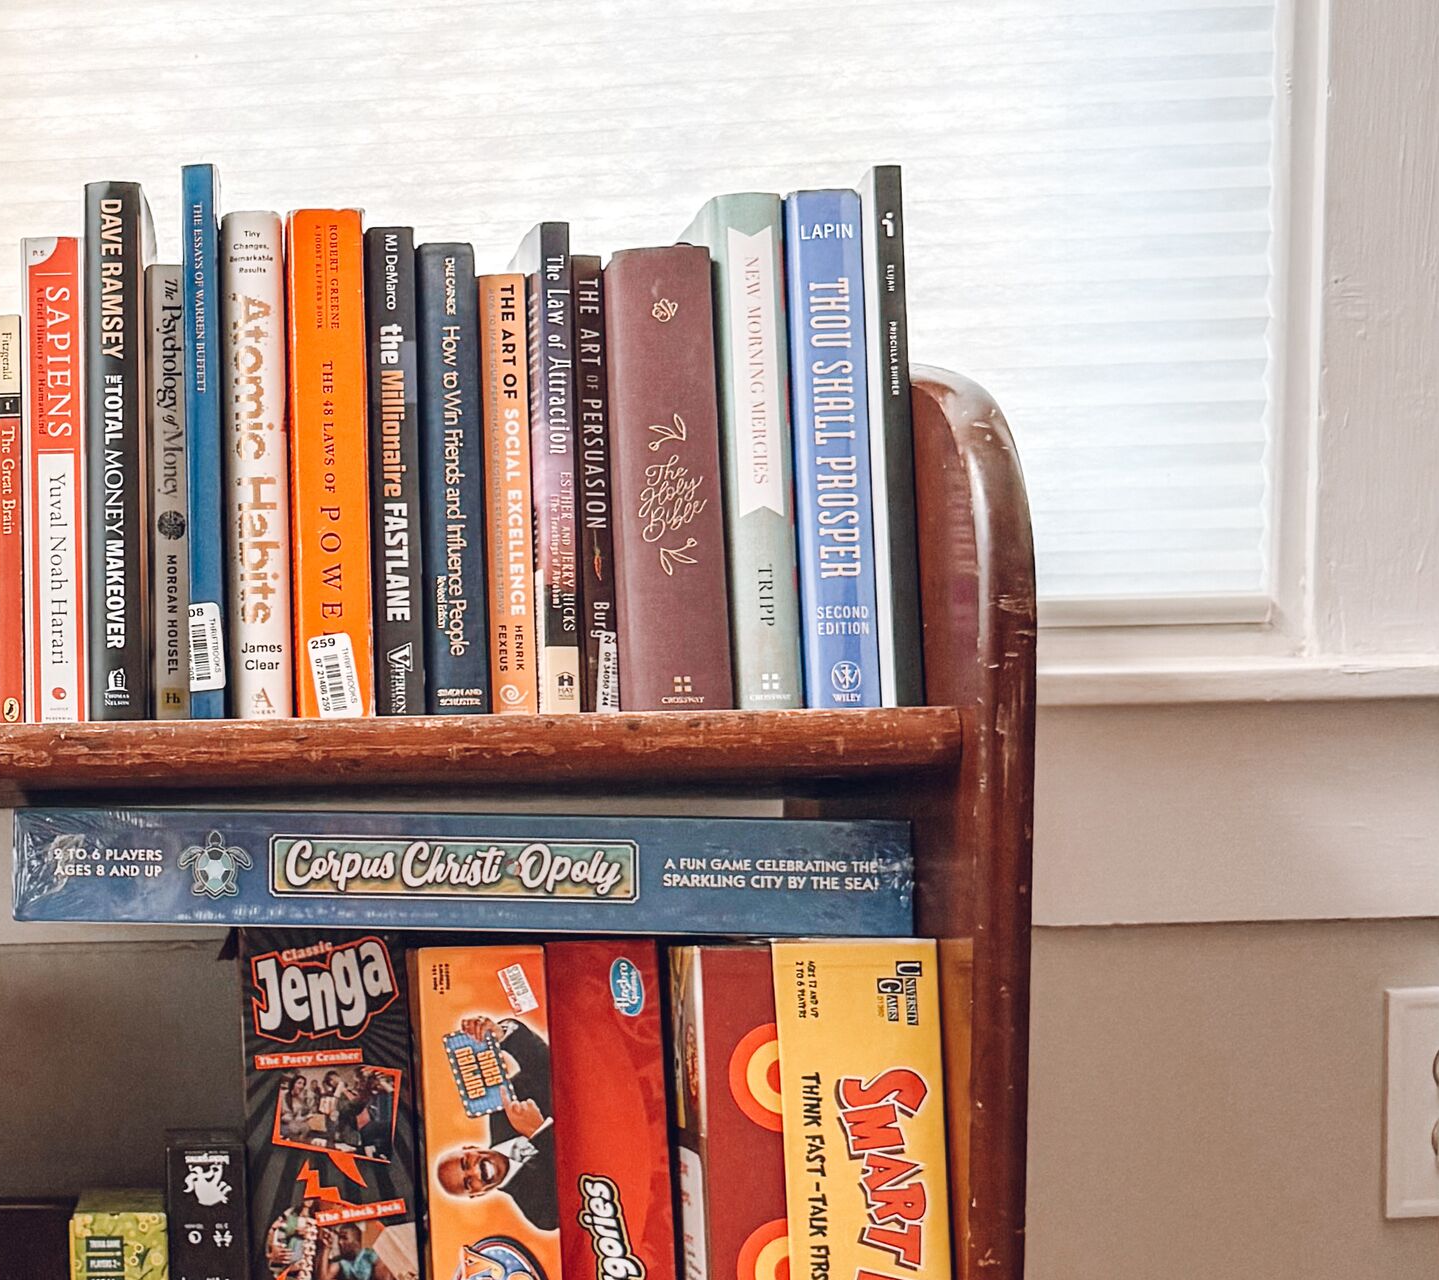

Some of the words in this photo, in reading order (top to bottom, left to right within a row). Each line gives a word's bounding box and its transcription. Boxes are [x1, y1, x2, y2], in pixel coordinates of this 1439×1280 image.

[100, 199, 122, 255] DAVE
[329, 225, 338, 273] ROBERT
[801, 224, 852, 240] LAPIN
[101, 263, 124, 359] RAMSEY
[330, 278, 340, 329] GREENE
[501, 285, 514, 321] THE
[809, 278, 851, 348] THOU
[46, 287, 72, 437] SAPIENS
[380, 323, 403, 364] the
[502, 330, 516, 366] ART
[323, 361, 333, 393] THE
[504, 374, 517, 399] OF
[323, 400, 333, 416] 48
[811, 360, 856, 445] SHALL
[323, 423, 335, 465] LAWS
[381, 370, 407, 498] Millionaire
[505, 408, 520, 481] SOCIAL
[49, 474, 66, 527] Yuval
[325, 475, 335, 493] OF
[816, 456, 861, 578] PROSPER
[50, 537, 68, 591] Noah
[320, 506, 342, 637] POWE
[384, 503, 411, 622] FASTLANE
[507, 491, 526, 616] EXCELLENCE
[167, 555, 177, 614] MORGAN
[758, 564, 775, 626] TRIPP
[51, 600, 68, 664] Harari
[817, 606, 868, 619] SECOND
[818, 623, 869, 635] EDITION
[168, 619, 177, 674] HOUSEL
[241, 642, 282, 654] James
[245, 660, 279, 670] Clear
[311, 638, 335, 650] 259
[53, 849, 63, 860] 2
[68, 849, 87, 860] TO
[92, 850, 101, 861] 6
[105, 849, 163, 861] PLAYERS
[54, 864, 92, 876] AGES
[96, 864, 105, 876] 8
[109, 864, 138, 877] AND
[143, 865, 162, 877] UP
[286, 840, 394, 892] Corpus
[400, 840, 502, 889] Christi
[517, 843, 623, 894] Opoly
[664, 858, 677, 870] A
[680, 859, 706, 871] FUN
[710, 860, 752, 872] GAME
[755, 860, 847, 873] CELEBRATING
[851, 861, 878, 874] THE
[662, 873, 747, 888] SPARKLING
[751, 875, 784, 889] CITY
[787, 876, 806, 890] BY
[810, 876, 840, 890] THE
[844, 877, 879, 891] SEA!
[282, 941, 333, 962] Classic
[257, 941, 393, 1031] Jenga
[614, 963, 629, 1010] Hasbro
[260, 1056, 279, 1065] The
[282, 1055, 313, 1065] Party
[316, 1052, 359, 1063] Crasher
[836, 1067, 928, 1267] SMART
